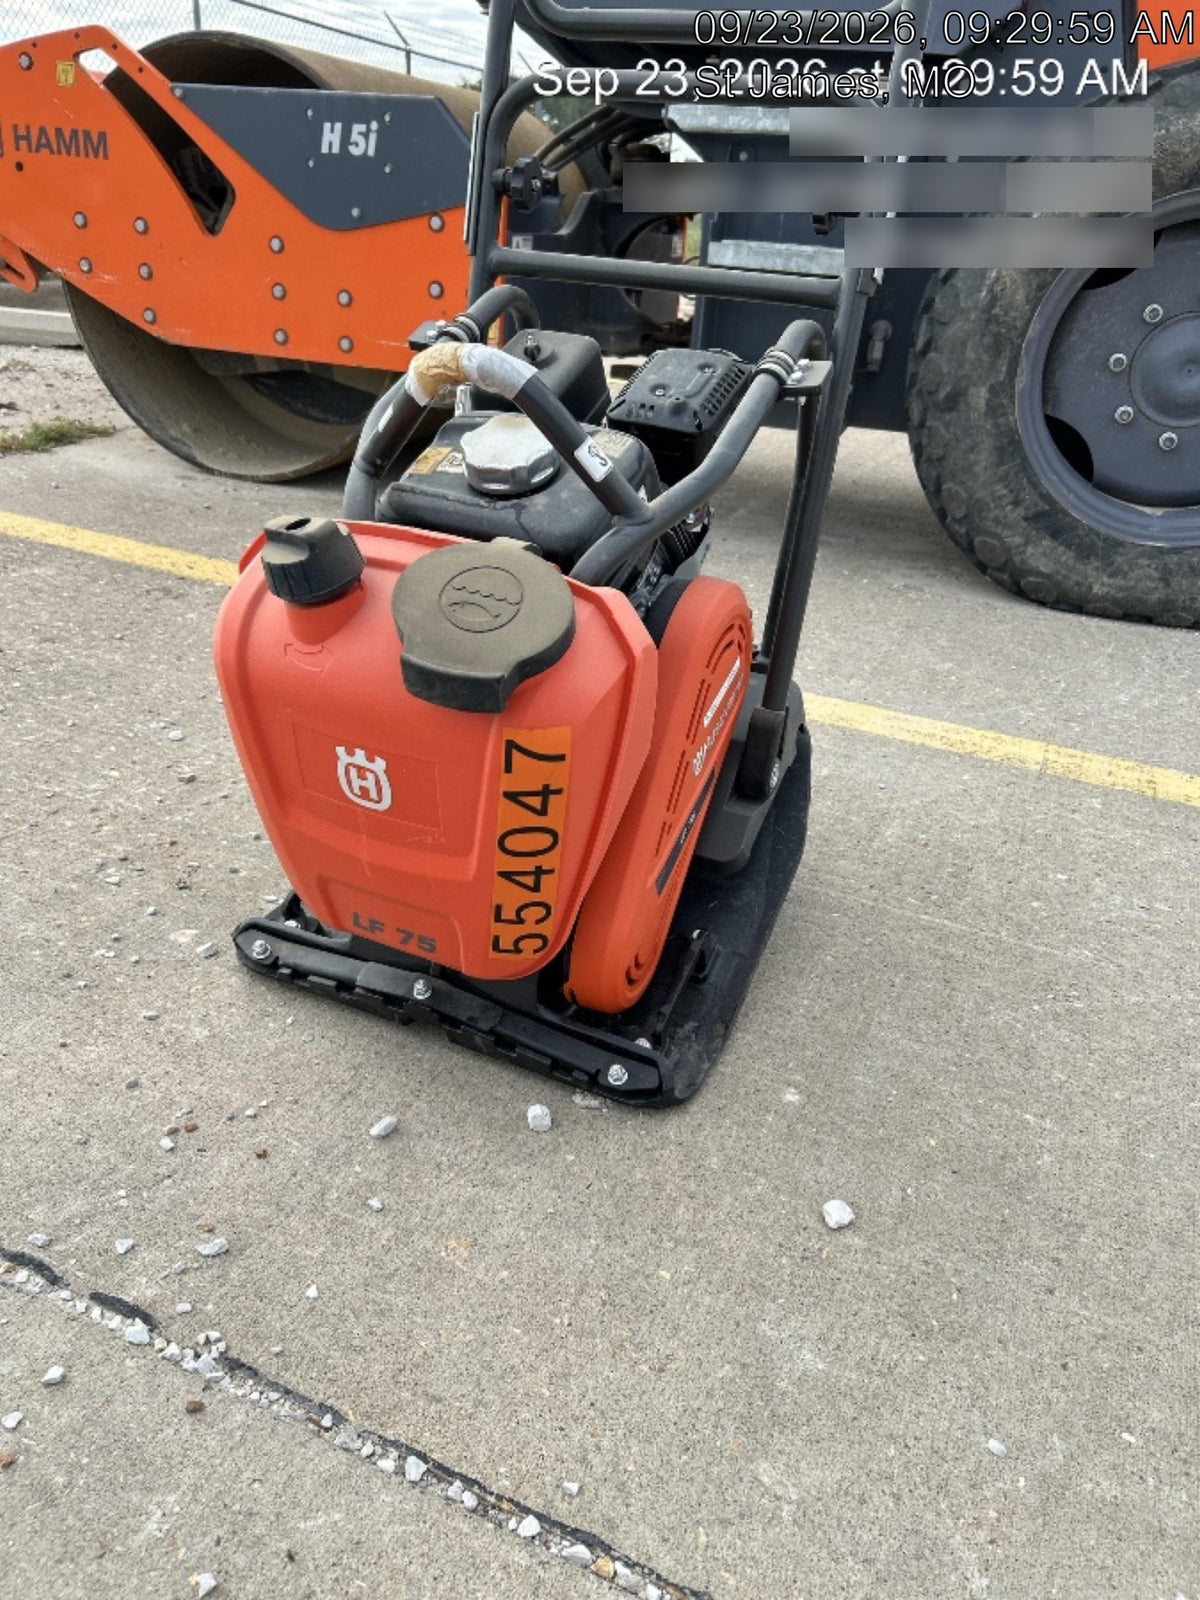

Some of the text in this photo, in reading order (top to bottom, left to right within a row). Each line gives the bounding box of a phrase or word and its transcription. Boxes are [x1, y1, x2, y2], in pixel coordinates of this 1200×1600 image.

[12, 123, 109, 161] HAMM
[321, 120, 379, 157] H 5i
[491, 738, 567, 956] 554047
[351, 911, 438, 953] LF 75
